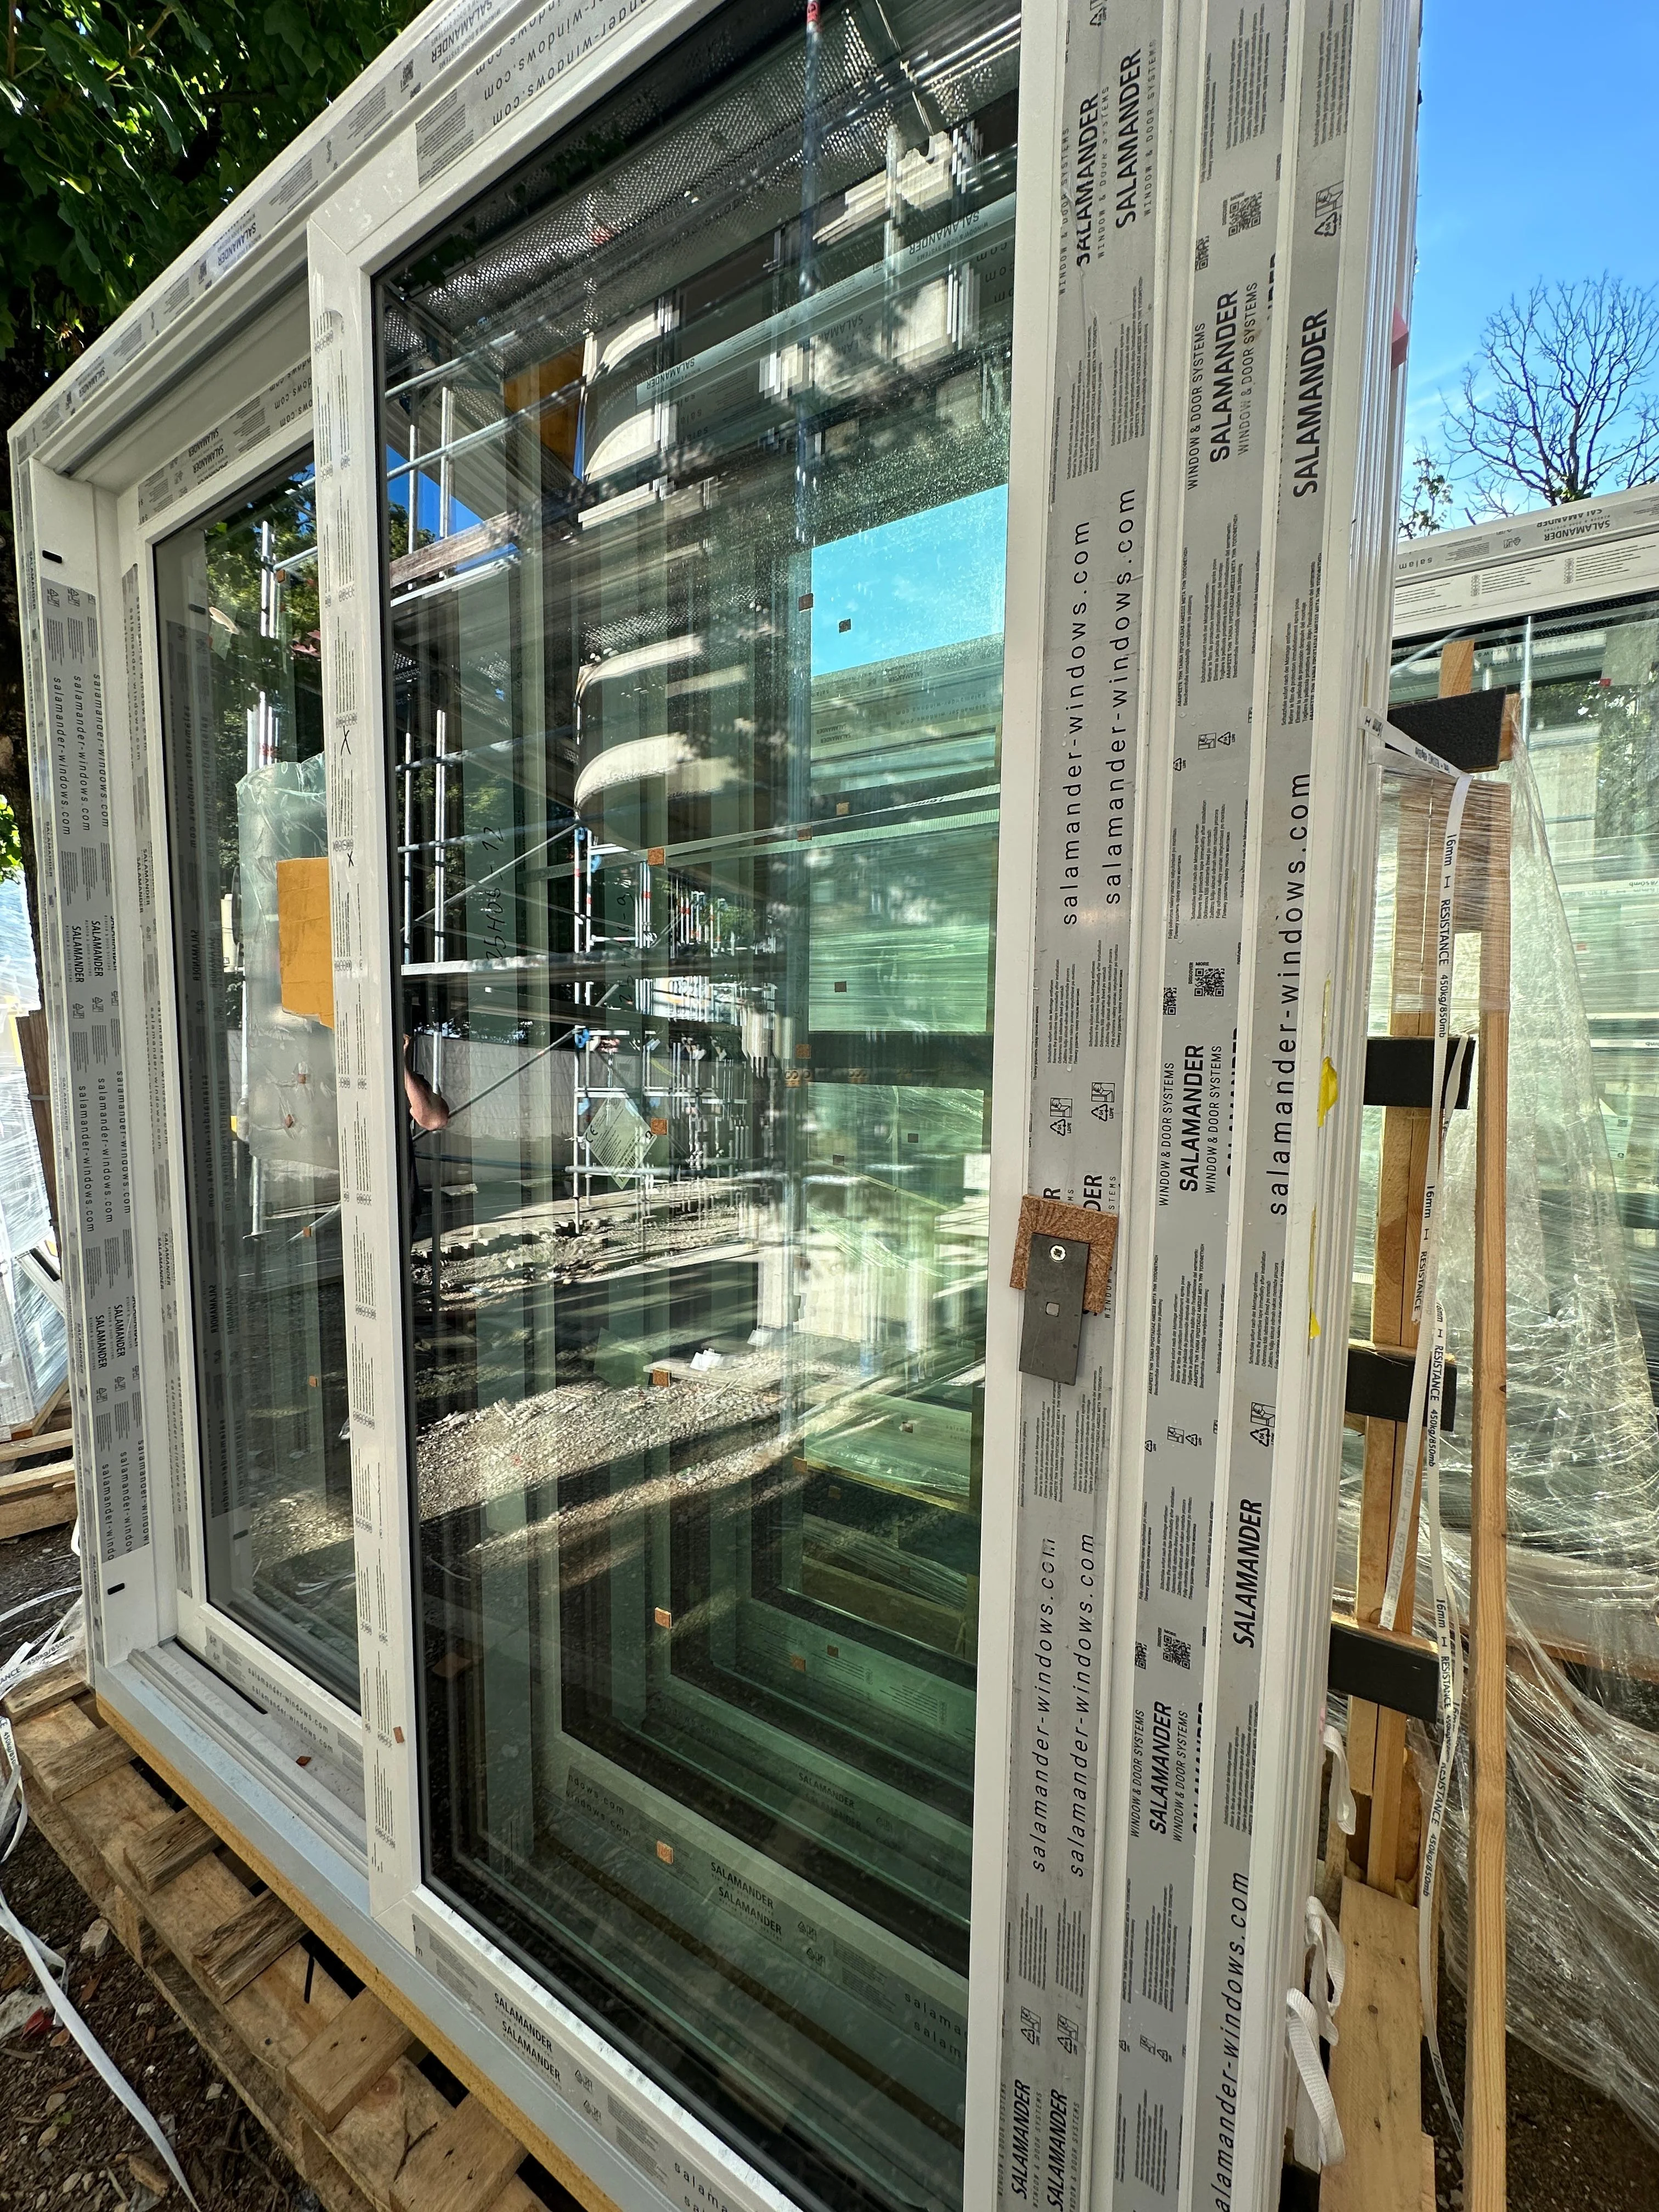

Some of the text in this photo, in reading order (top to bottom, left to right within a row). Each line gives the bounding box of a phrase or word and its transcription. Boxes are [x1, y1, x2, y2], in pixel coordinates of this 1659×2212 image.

[432, 2, 494, 63] SALAMANDER
[484, 0, 603, 100] r-windows.com
[493, 0, 647, 126] nder-windows.com
[1147, 40, 1156, 99] SYSTEMS
[1076, 93, 1098, 267] SALAMANDER
[1116, 48, 1141, 229] SALAMANDER
[1146, 108, 1154, 142] DOOR
[1144, 167, 1153, 216] WINDOW
[1059, 247, 1067, 295] WINDOW
[647, 357, 695, 389] SALAMANDER
[1188, 323, 1205, 490] WINDOW & DOOR SYSTEMS
[1210, 290, 1238, 462] SALAMANDER
[1238, 283, 1257, 455] WINDOW & DOOR SYSTEMS
[1293, 308, 1328, 498] SALAMANDER
[193, 444, 224, 473] SALAMANDER
[1544, 520, 1611, 541] SALAMANDER
[1060, 521, 1090, 925] salamander-windows.com
[1103, 488, 1136, 905] salamander-windows.com
[54, 677, 70, 835] salamander-windows.com
[74, 675, 90, 831] salamander-windows.com
[72, 926, 84, 983] SALAMANDER
[92, 921, 103, 977] SALAMANDER
[1438, 834, 1457, 1038] 16mm RESISTANCE 450kg/850mb
[1267, 774, 1311, 1215] salamander-windows.com
[1161, 1116, 1172, 1148] DOOR
[1163, 1062, 1175, 1114] SYSTEMS
[1180, 1045, 1204, 1192] SALAMANDER
[1205, 1046, 1222, 1193] WINDOW & DOOR SYSTEMS
[79, 1086, 94, 1232] salamander-windows.com
[98, 1079, 113, 1223] salamander-windows.com
[1159, 1161, 1170, 1206] WINDOW
[1414, 1185, 1435, 1311] 16mm RESISTANCE
[95, 1314, 108, 1369] SALAMANDER
[114, 1304, 126, 1358] SALAMANDER
[1430, 1345, 1444, 1401] RESISTANCE
[1428, 1409, 1438, 1468] 450kg/850mb
[1233, 1499, 1262, 1648] SALAMANDER
[247, 1667, 329, 1735] salamander-windows.com
[1068, 1534, 1094, 1877] salamander-windows.com
[1436, 1598, 1451, 1709] 16mm RESISTANCE
[251, 1685, 334, 1755] salamander-windows.com
[1130, 1709, 1145, 1838] WINDOW & DOOR SYSTEMS
[1149, 1701, 1171, 1835] SALAMANDER
[798, 1771, 856, 1809] SALAMANDER
[1173, 1710, 1188, 1842] WINDOW & DOOR SYSTEMS
[710, 1862, 774, 1910] SALAMANDER
[719, 1886, 782, 1936] SALAMANDER
[1424, 1833, 1436, 1897] 450kg/850mb
[494, 1993, 553, 2052] SALAMANDER
[501, 2021, 561, 2082] SALAMANDER
[1211, 1872, 1250, 2212] alamander-windows.com
[1011, 2079, 1030, 2200] SALAMANDER
[1047, 2089, 1067, 2212] SALAMANDER
